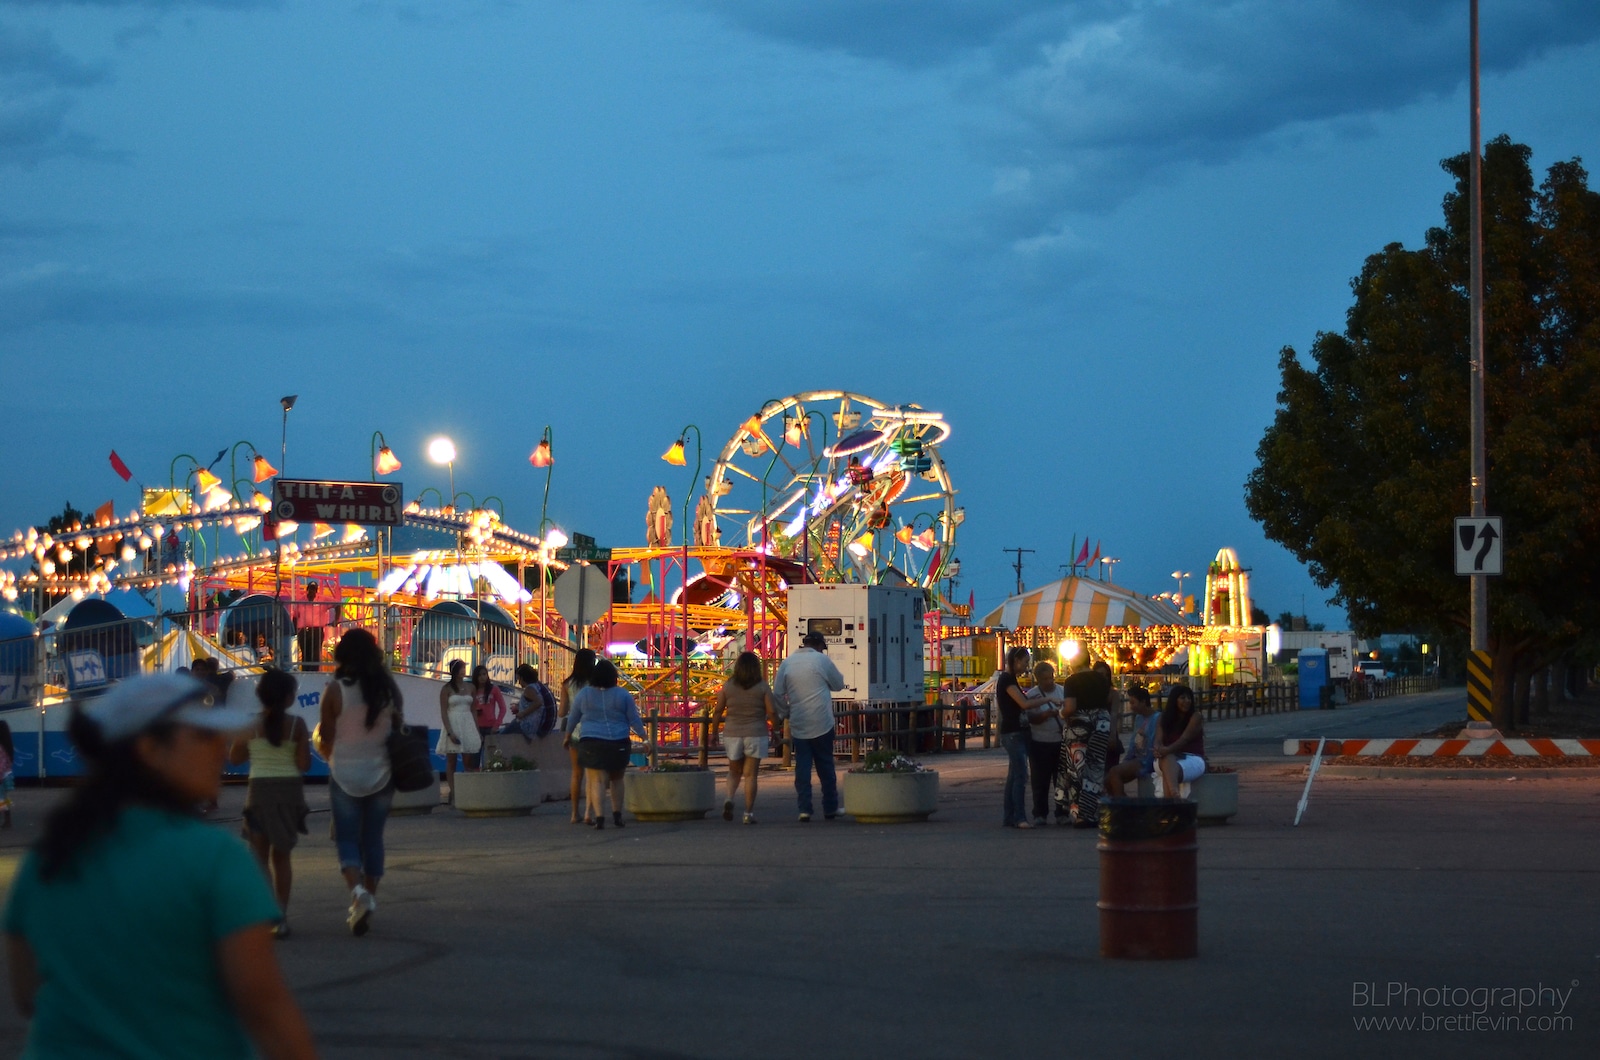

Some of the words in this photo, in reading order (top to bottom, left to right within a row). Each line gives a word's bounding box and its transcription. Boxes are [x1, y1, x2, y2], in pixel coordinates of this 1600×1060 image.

[281, 483, 363, 500] TILT-A-
[316, 504, 395, 521] WHIRL
[571, 549, 577, 559] N
[594, 549, 609, 559] Ave
